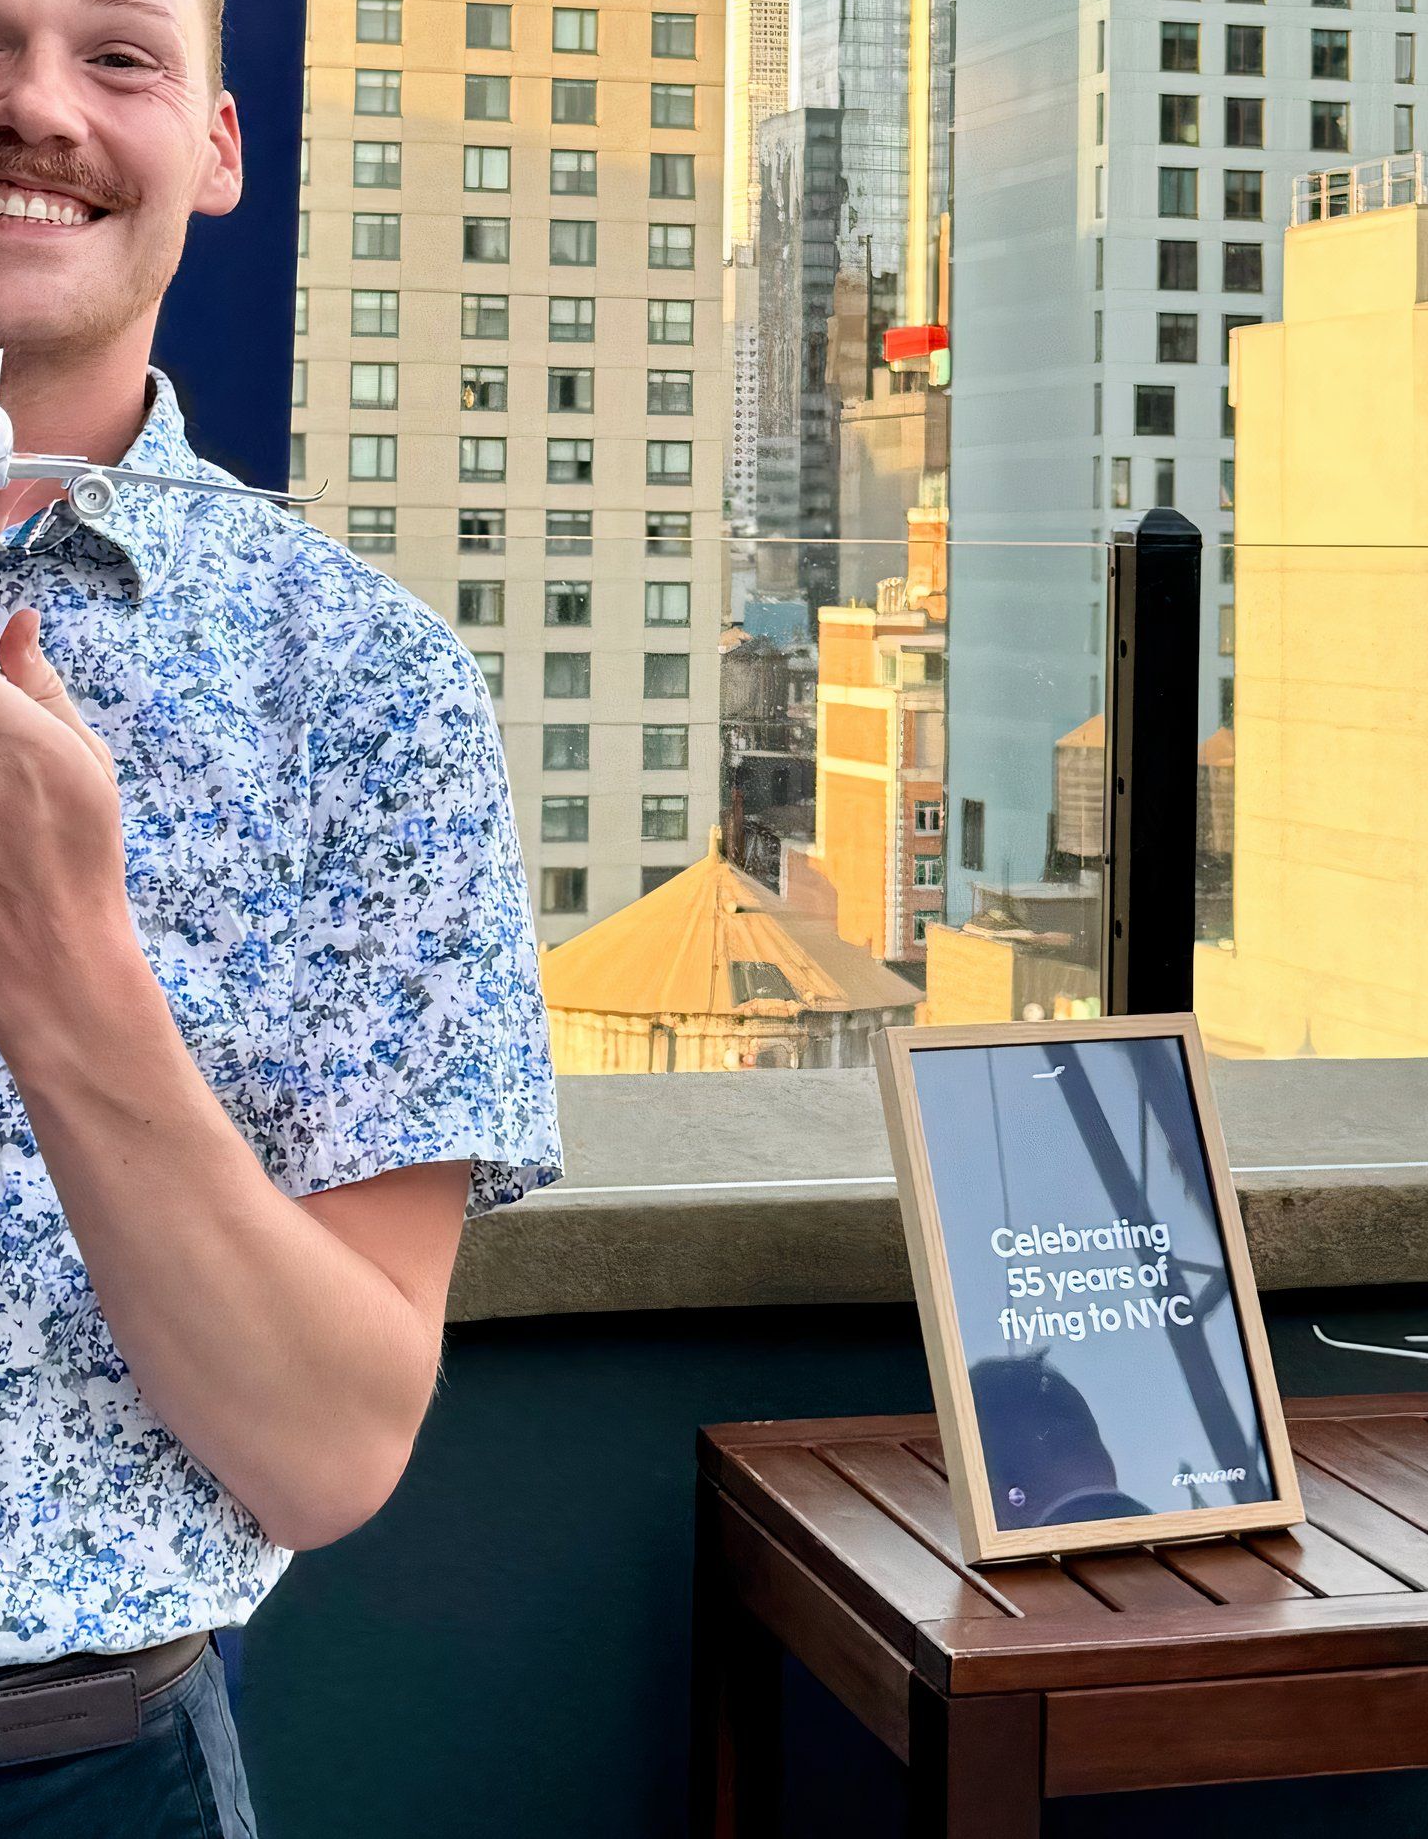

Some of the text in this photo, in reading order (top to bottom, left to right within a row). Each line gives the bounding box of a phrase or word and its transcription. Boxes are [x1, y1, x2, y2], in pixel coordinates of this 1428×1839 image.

[990, 1218, 1171, 1258] Celebrating
[1007, 1255, 1169, 1302] 55 years of
[997, 1294, 1194, 1345] flying to NYC
[1171, 1467, 1247, 1487] FINNAIR
